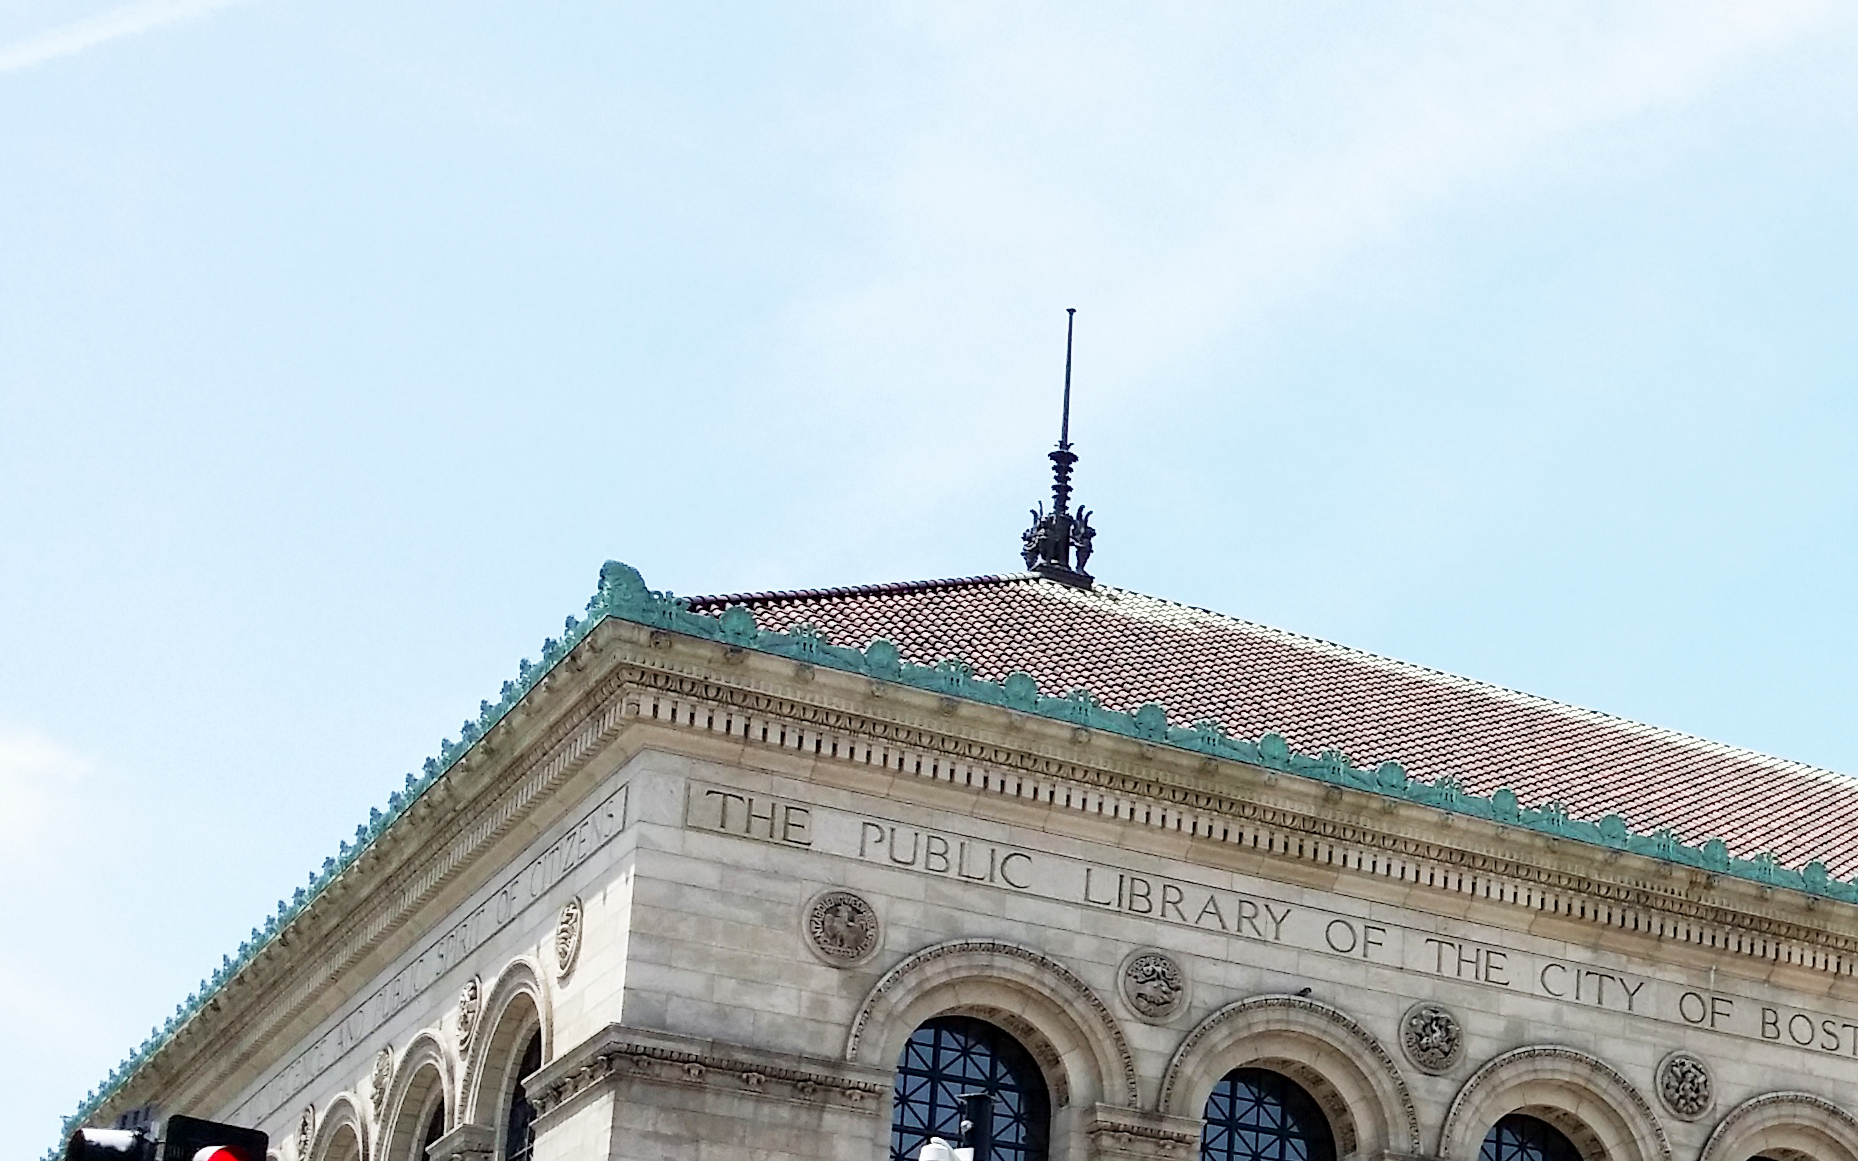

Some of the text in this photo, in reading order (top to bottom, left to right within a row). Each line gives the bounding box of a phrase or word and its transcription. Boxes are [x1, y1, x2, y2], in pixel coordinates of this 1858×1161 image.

[530, 800, 614, 897] CITIZENS
[705, 789, 812, 847] THE
[859, 820, 1033, 891] PUBLIC
[1084, 867, 1293, 941] LIBRARY
[1325, 918, 1387, 958] OF
[1425, 937, 1510, 986] THE
[1540, 962, 1645, 1011] CITY
[1679, 990, 1733, 1029] OF
